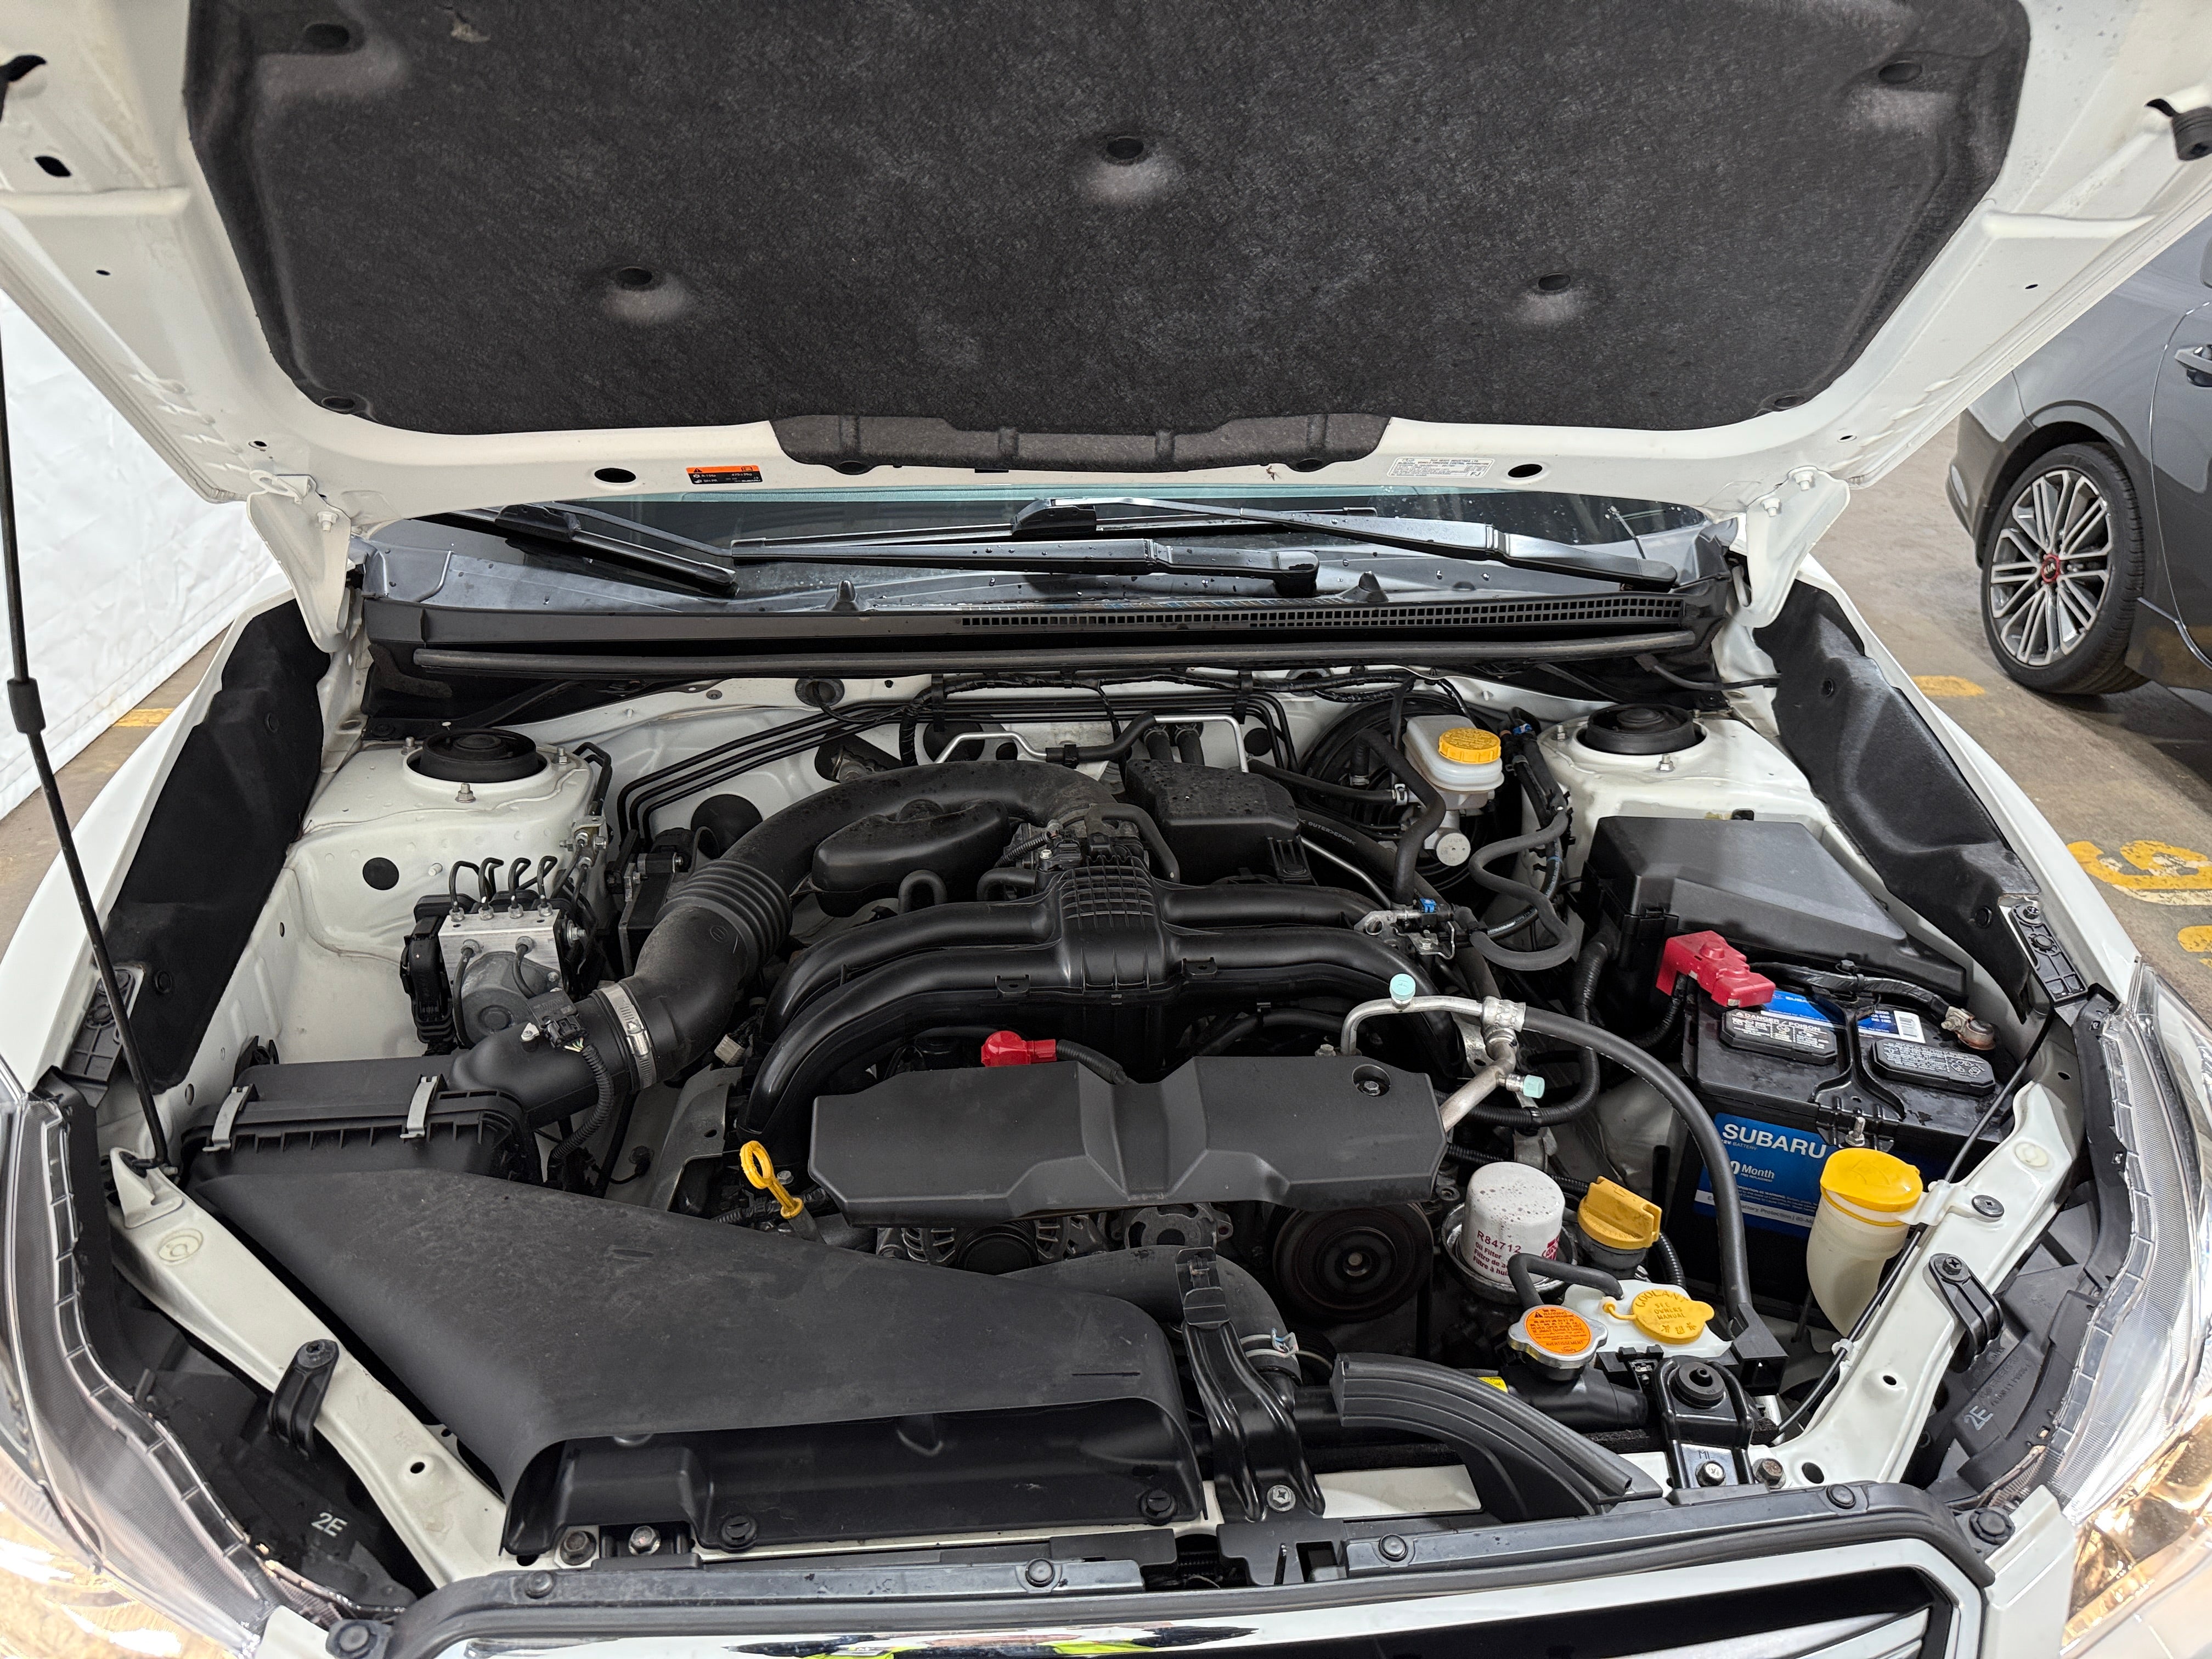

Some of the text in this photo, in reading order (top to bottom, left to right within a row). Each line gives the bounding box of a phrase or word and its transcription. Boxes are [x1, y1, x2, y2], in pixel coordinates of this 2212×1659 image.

[1745, 1013, 1780, 1024] DANGER
[1788, 1022, 1821, 1031] POISON
[1722, 1123, 1827, 1159] SUBARU
[1732, 1142, 1758, 1151] BATTERY
[1741, 1164, 1775, 1179] Month
[1741, 1204, 1759, 1213] attery
[1760, 1207, 1792, 1219] Protection
[1477, 1230, 1521, 1254] R84712
[1474, 1248, 1491, 1262] Filtro
[1484, 1247, 1502, 1260] Filter
[1473, 1256, 1488, 1269] Filtre
[1496, 1268, 1509, 1276] hui
[1635, 1290, 1689, 1307] COOLANT
[1656, 1312, 1686, 1320] MANUAL
[1963, 1405, 1994, 1431] 2E
[311, 1511, 348, 1537] 2E
